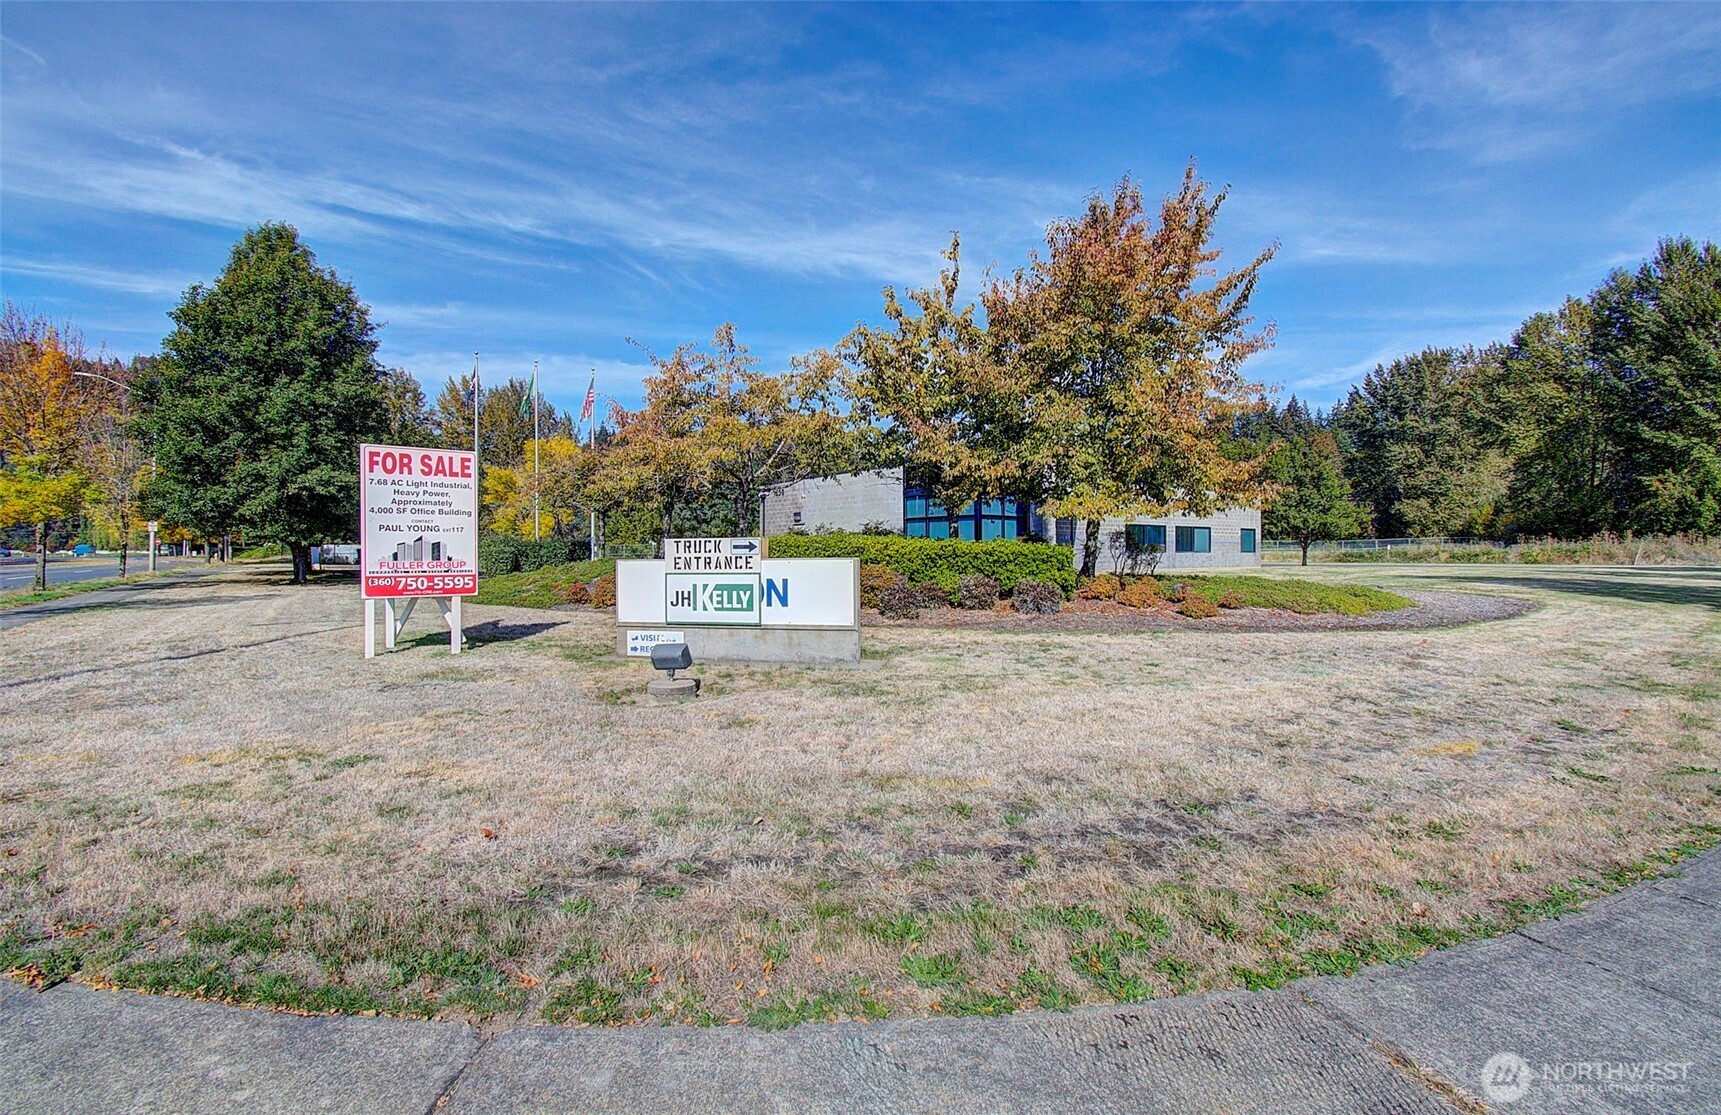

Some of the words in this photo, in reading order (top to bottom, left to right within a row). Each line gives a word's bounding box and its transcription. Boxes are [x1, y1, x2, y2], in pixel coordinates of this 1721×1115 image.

[368, 451, 412, 475] FOR
[420, 454, 472, 478] SALE
[369, 478, 388, 486] 7.68
[390, 479, 403, 487] AC
[406, 480, 428, 489] Light
[430, 481, 472, 490] Industrial,
[393, 489, 420, 498] Heavy
[422, 490, 451, 498] Power,
[391, 498, 453, 508] Approximately
[396, 507, 407, 515] SF
[410, 507, 436, 515] Office
[438, 508, 472, 517] Building
[378, 524, 404, 532] PAUL
[406, 524, 440, 533] YOUNG
[674, 540, 722, 554] TRUCK
[380, 561, 424, 570] FULLER
[427, 561, 466, 569] GROUP
[673, 556, 753, 570] ENTRANCE
[368, 577, 395, 586] (360)
[396, 576, 474, 590] 750-5595
